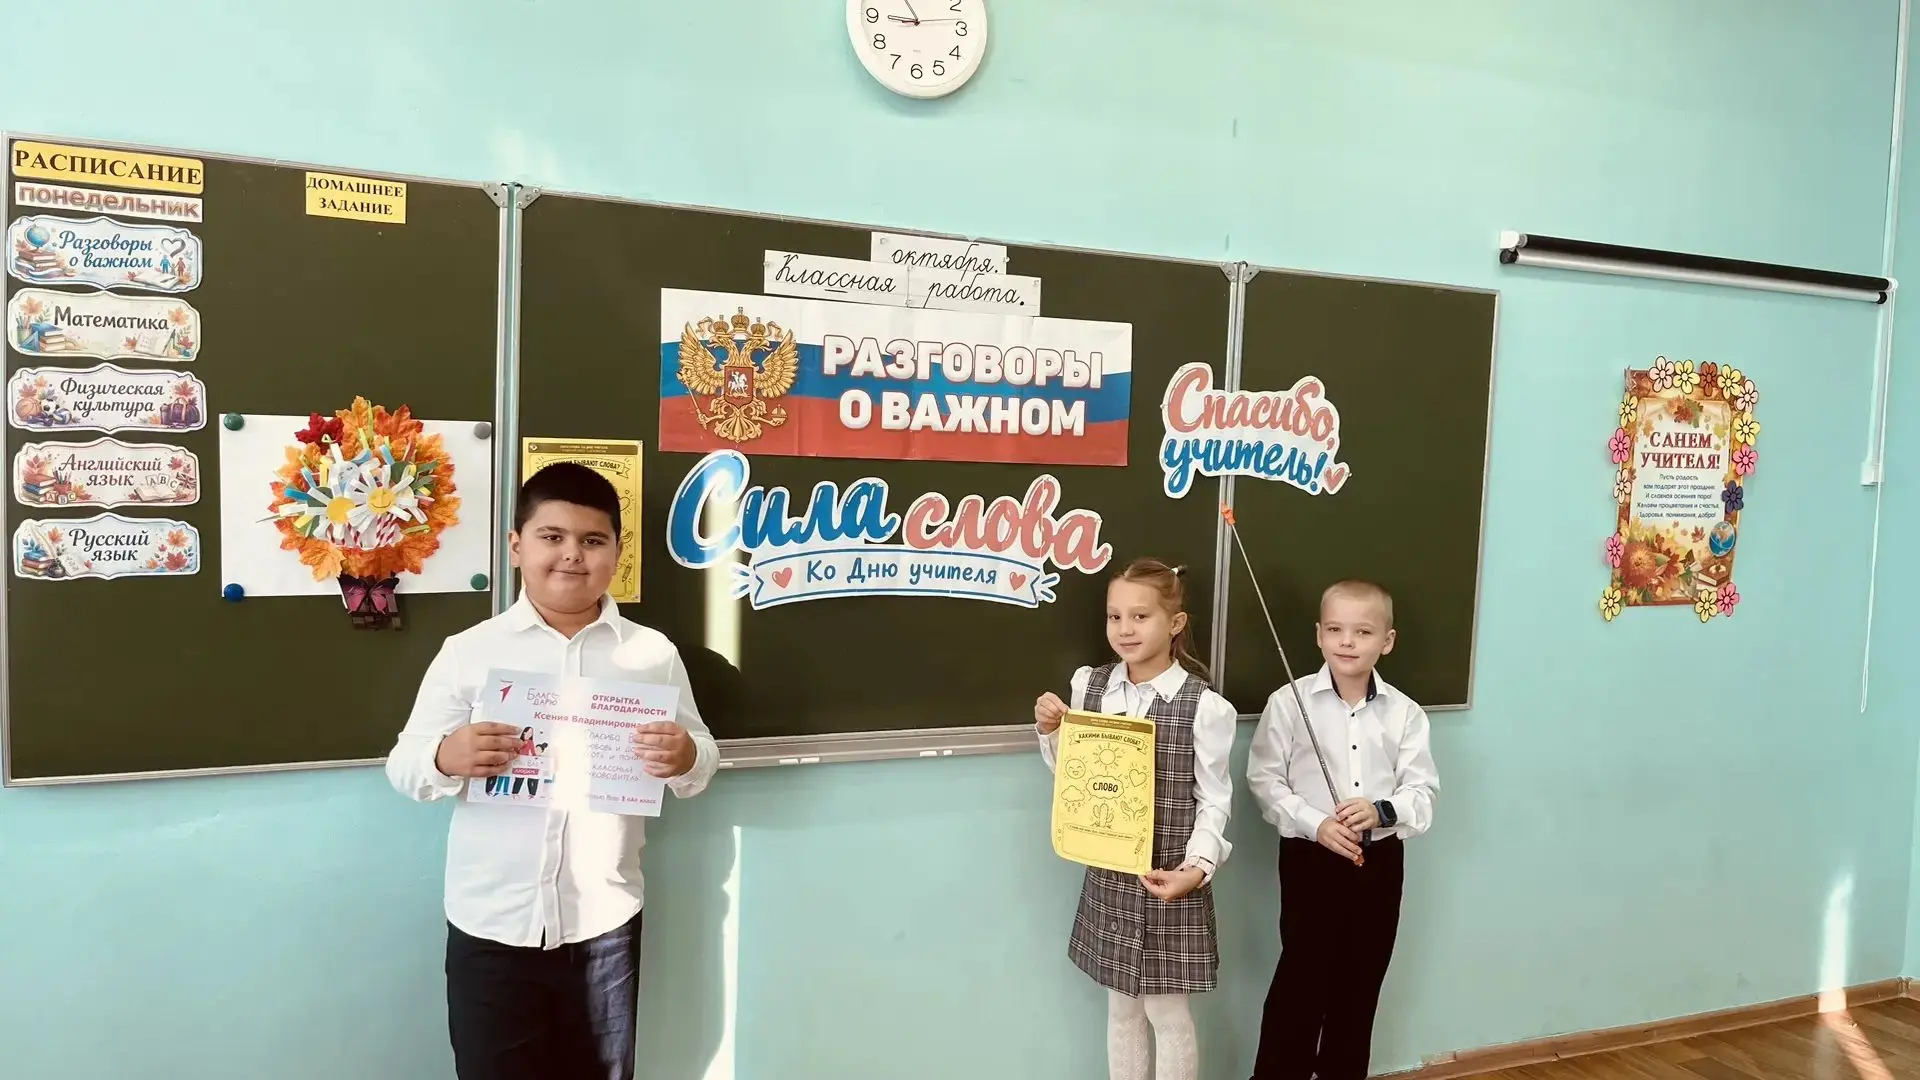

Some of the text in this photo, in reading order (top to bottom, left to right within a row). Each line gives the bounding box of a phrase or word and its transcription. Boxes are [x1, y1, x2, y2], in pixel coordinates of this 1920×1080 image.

[866, 7, 879, 23] 9
[950, 0, 961, 12] 2
[955, 21, 968, 36] 3
[873, 34, 886, 49] 8
[890, 54, 901, 69] 7
[949, 45, 961, 60] 4
[910, 64, 923, 79] 6
[932, 60, 945, 76] 5
[15, 150, 201, 185] РАСПИСАНИЕ
[306, 177, 403, 198] ДОМАШНЕЕ
[19, 186, 200, 219] понедельник
[319, 197, 393, 216] ЗАДАНИЕ
[58, 230, 153, 256] Разговоры
[69, 252, 153, 269] о важном
[892, 244, 998, 284] октября.
[774, 254, 1025, 308] Классная работа.
[54, 306, 169, 330] Математика
[823, 335, 1102, 389] РАЗГОВОРЫ
[60, 377, 164, 399] Физическая
[73, 399, 155, 417] культура
[839, 389, 1085, 436] О ВАЖНОМ
[1168, 367, 1335, 450] Спасибо,
[59, 453, 162, 472] Английский
[1164, 438, 1328, 493] учитель!
[1640, 453, 1720, 470] УЧИТЕЛЯ!
[86, 475, 134, 486] язык
[671, 453, 1110, 570] Сила слова
[69, 528, 150, 552] Русский
[91, 550, 138, 561] язык
[806, 557, 997, 585] Ко Дню учителя
[592, 694, 640, 705] ОТКРЫТКА
[534, 711, 568, 721] Ксения
[591, 703, 667, 716] БЛАГОДАРНОСТИ
[1092, 782, 1118, 793] СЛОВО
